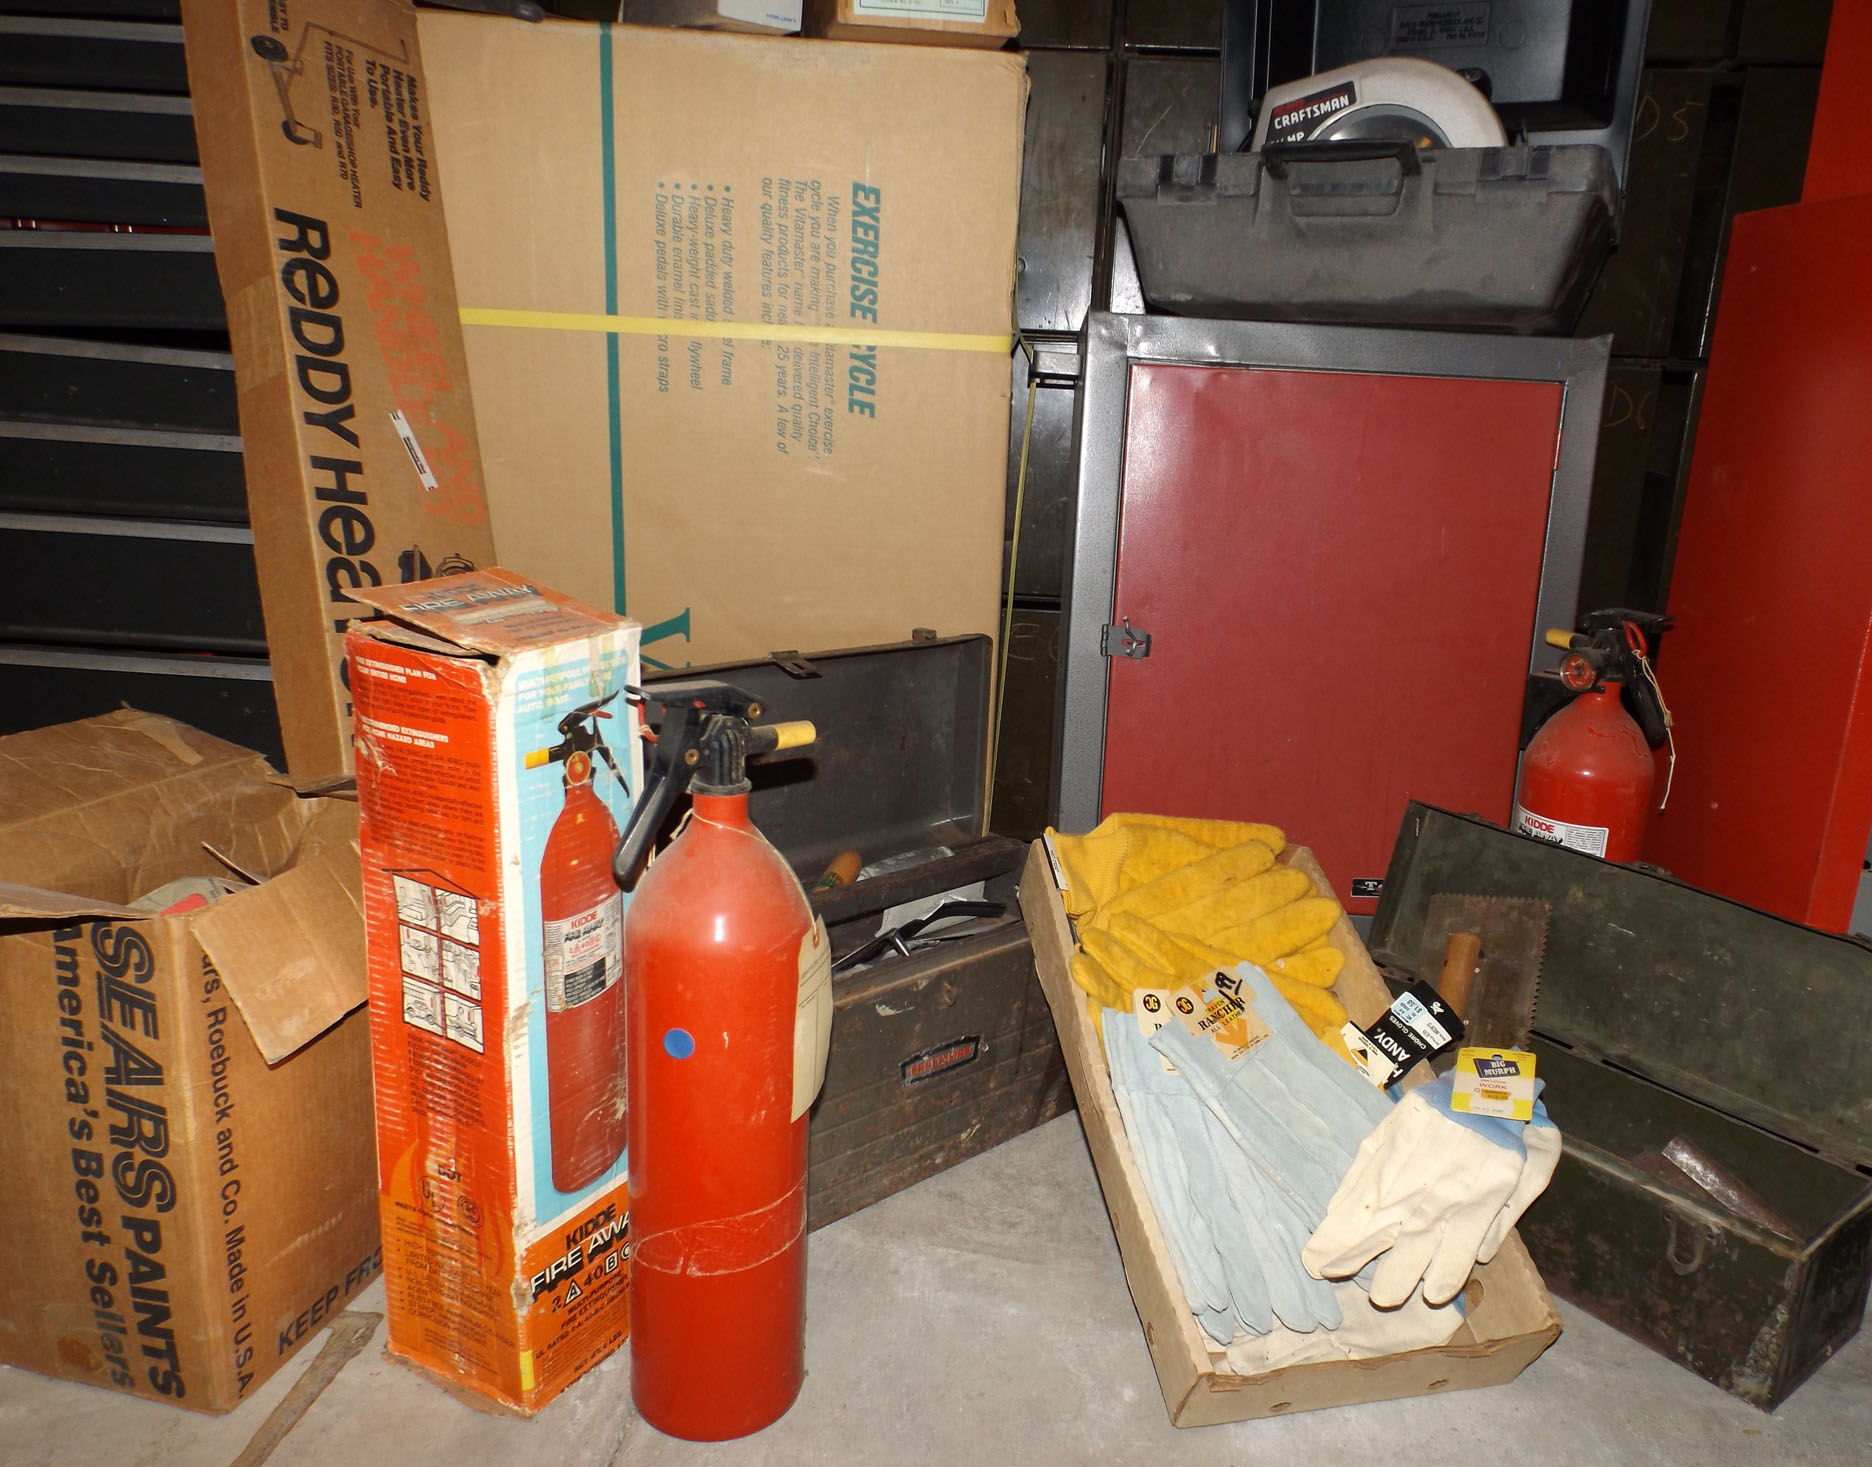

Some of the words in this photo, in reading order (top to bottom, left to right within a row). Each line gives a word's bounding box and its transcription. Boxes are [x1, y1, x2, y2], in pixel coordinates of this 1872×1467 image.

[365, 59, 377, 75] To
[380, 63, 394, 123] Portable
[392, 69, 406, 121] Heater
[407, 75, 419, 121] Makes
[1274, 94, 1350, 130] CRAFTSMAN
[386, 125, 398, 154] And
[398, 118, 410, 154] Even
[412, 125, 424, 158] Your
[390, 156, 403, 192] Easy
[404, 155, 415, 192] More
[416, 157, 430, 203] Reddy
[763, 178, 773, 200] our
[794, 180, 808, 202] The
[655, 194, 668, 237] Deluxe
[721, 197, 734, 236] Heavy
[776, 178, 791, 220] fitness
[808, 179, 822, 212] cycle
[827, 196, 840, 230] When
[671, 194, 684, 242] Durable
[687, 195, 701, 278] Heavy-weight
[704, 196, 717, 238] Deluxe
[760, 203, 773, 245] quality
[809, 214, 821, 239] you
[654, 241, 668, 281] pedals
[704, 241, 717, 288] padded
[721, 240, 734, 267] duty
[777, 223, 790, 278] products
[811, 242, 821, 262] are
[824, 232, 837, 257] you
[849, 181, 881, 324] EXERCISE
[672, 248, 684, 293] enamel
[761, 249, 774, 299] features
[807, 265, 821, 313] making
[823, 263, 837, 320] purchase
[656, 285, 668, 311] with
[688, 282, 701, 308] cast
[722, 271, 734, 315] welded
[777, 284, 790, 302] for
[794, 281, 804, 318] name
[387, 243, 451, 400] WHEEL
[656, 355, 669, 393] straps
[688, 341, 703, 390] flywheel
[721, 352, 734, 386] frame
[792, 347, 805, 400] delivered
[807, 351, 820, 410] Intelligent
[776, 417, 790, 439] few
[790, 403, 805, 442] quality
[822, 408, 835, 455] exercise
[310, 456, 383, 747] Hea
[1525, 815, 1555, 834] KIDDE
[571, 910, 598, 929] KIDDE
[1389, 1015, 1409, 1034] GLOVES
[1407, 1031, 1427, 1050] CHORE
[90, 919, 177, 1214] SEARS
[206, 1008, 236, 1125] Roebuck
[1374, 1031, 1412, 1062] ANDY
[1490, 1060, 1506, 1068] BIG
[1480, 1082, 1508, 1090] WORK
[1484, 1067, 1517, 1076] MURPH
[216, 1128, 238, 1178] and
[71, 1147, 112, 1248] Best
[221, 1179, 240, 1226] Co.
[565, 1202, 617, 1250] KIDDE
[221, 1227, 246, 1296] Made
[529, 1245, 583, 1296] FIRE
[588, 1209, 630, 1256] AWA
[122, 1215, 185, 1400] PAINTS
[278, 1285, 339, 1356] KEEP
[344, 1244, 383, 1297] FRO
[551, 1295, 562, 1313] 2
[583, 1263, 604, 1287] 40
[85, 1258, 135, 1389] Sellers
[231, 1300, 247, 1326] in
[561, 1311, 578, 1330] FIRE
[546, 1331, 570, 1354] RATED
[234, 1329, 253, 1400] U.S.A.
